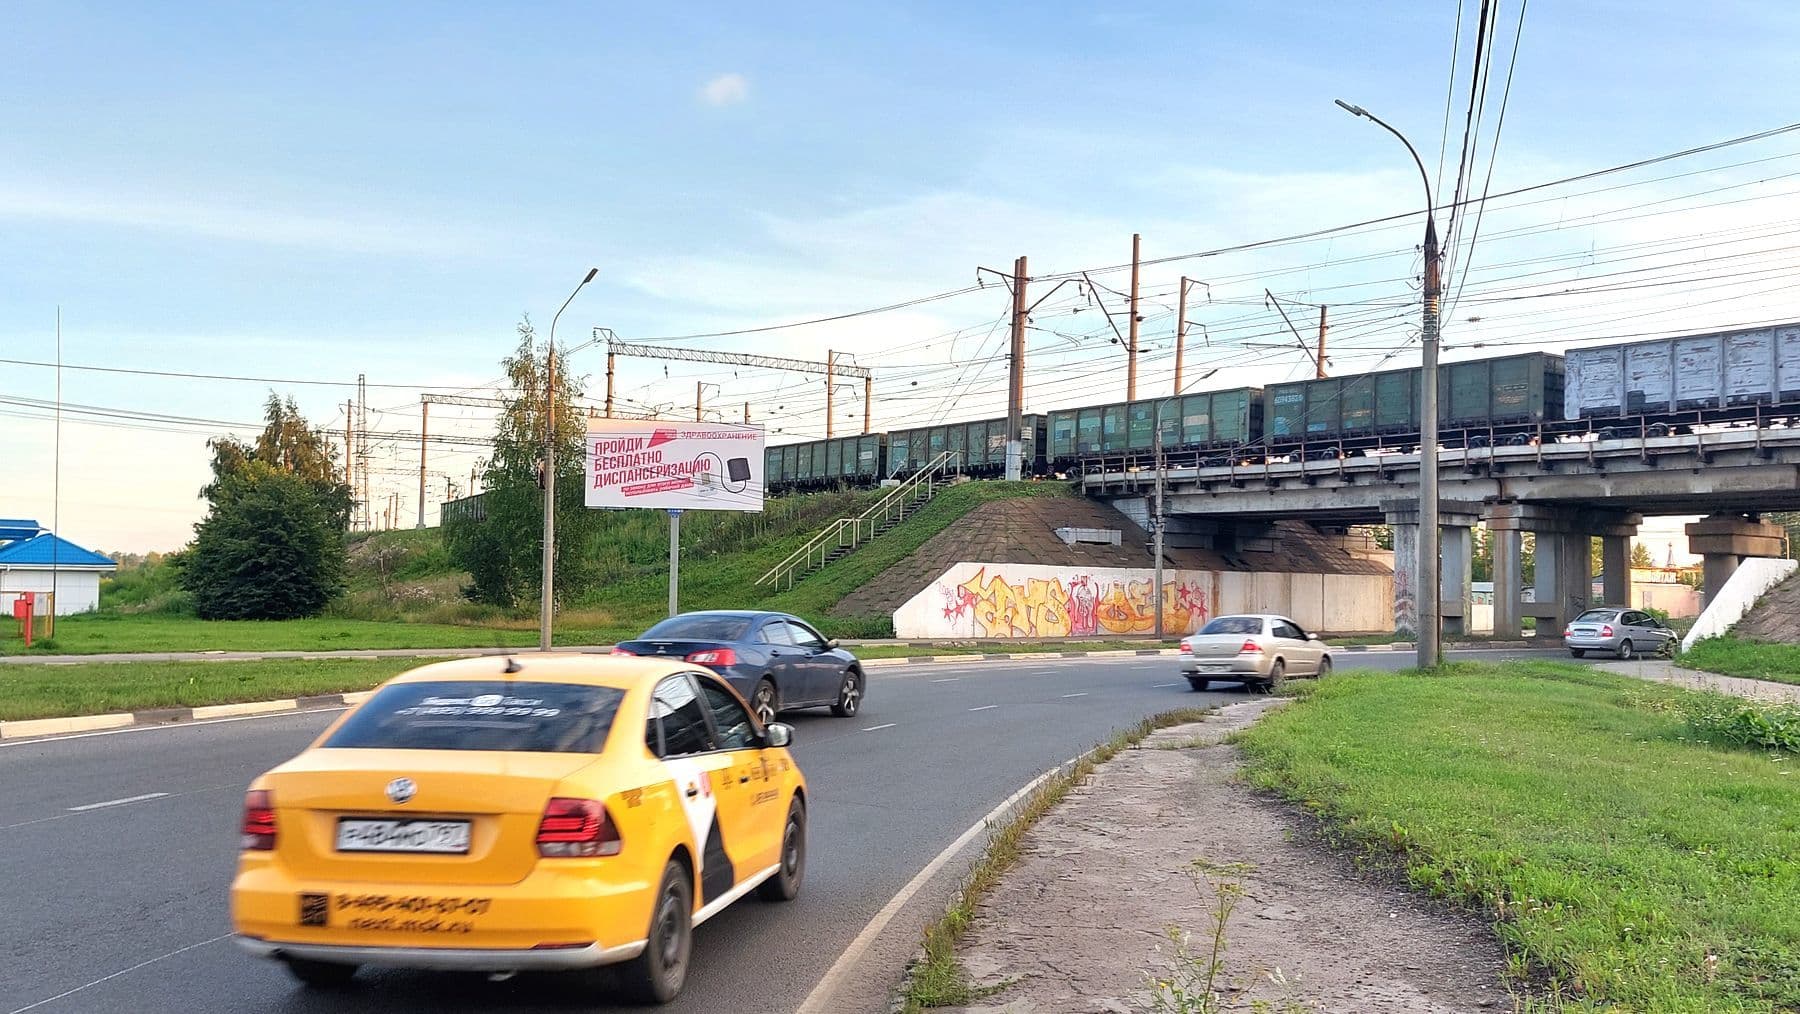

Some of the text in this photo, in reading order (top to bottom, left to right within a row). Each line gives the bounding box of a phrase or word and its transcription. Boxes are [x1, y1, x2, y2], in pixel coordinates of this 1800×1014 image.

[681, 431, 757, 440] ЗДРАВООХРАНЕНИЕ
[595, 437, 643, 456] ПРОЙДИ
[594, 450, 662, 472] БЕСПЛАТНО
[594, 458, 711, 489] ДИСПАНСЕРИЗАЦИЮ
